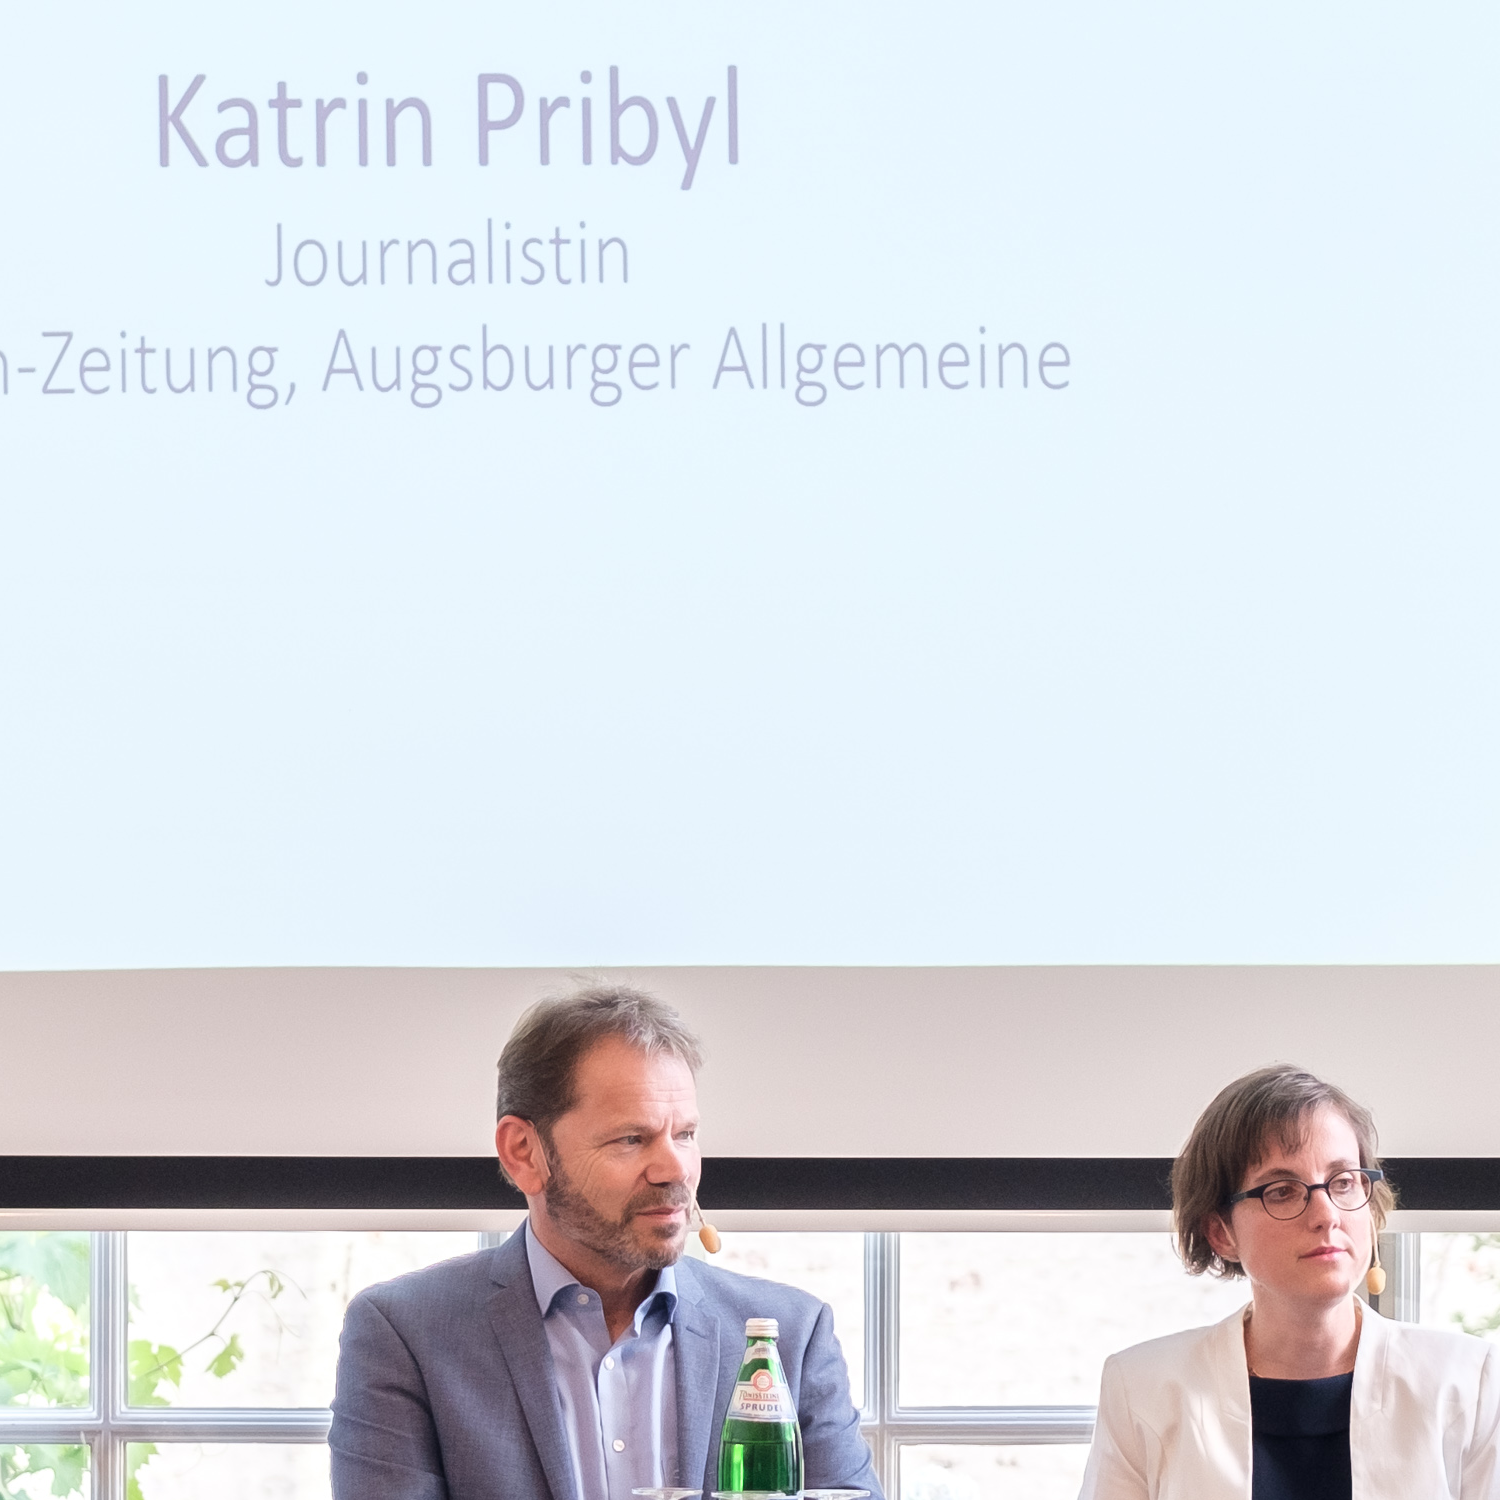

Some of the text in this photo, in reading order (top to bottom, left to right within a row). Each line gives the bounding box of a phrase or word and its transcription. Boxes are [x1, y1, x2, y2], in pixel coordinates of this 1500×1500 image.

[157, 64, 741, 192] Katrin Pribyl
[264, 217, 630, 288] Journalistin
[321, 323, 693, 411] Augsburger
[711, 322, 1073, 409] Allgemeine
